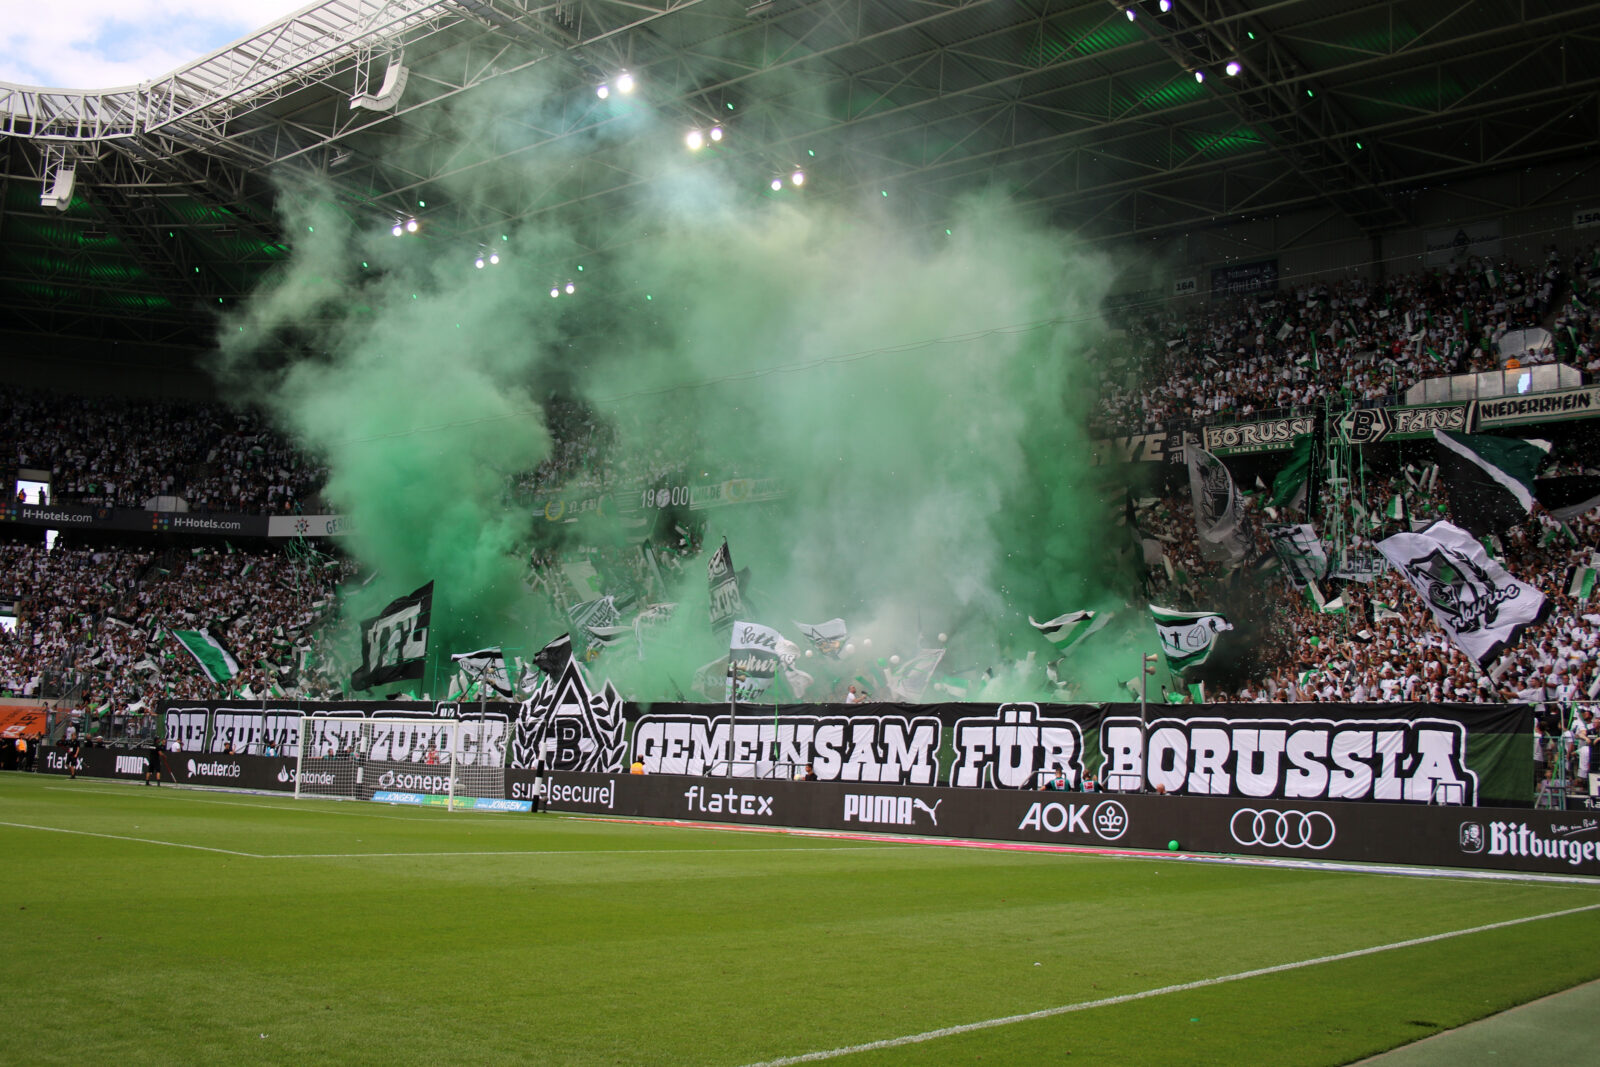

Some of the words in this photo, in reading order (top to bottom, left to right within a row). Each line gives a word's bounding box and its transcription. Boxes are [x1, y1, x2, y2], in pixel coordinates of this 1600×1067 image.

[1481, 392, 1591, 419] NIEDERRHEIN
[1395, 408, 1466, 432] FANS
[1208, 418, 1315, 448] BORUSSI
[1228, 444, 1263, 454] IMMER
[23, 508, 93, 523] H-Hotels.com
[174, 517, 241, 530] H-Hotels.com
[47, 751, 83, 770] flatx
[115, 755, 144, 774] PUMA
[165, 711, 208, 753] DIE
[211, 712, 301, 758] KURVE
[311, 716, 364, 760] IST
[370, 707, 507, 768] ZURÜCK
[635, 720, 939, 786] GEMEINSAM
[957, 709, 1078, 790] FÜR
[1105, 724, 1466, 804] BORUSSIA
[197, 761, 241, 778] reuter.de
[289, 769, 335, 785] Sntander
[844, 794, 913, 825] PUMA
[1018, 802, 1091, 834] AOK
